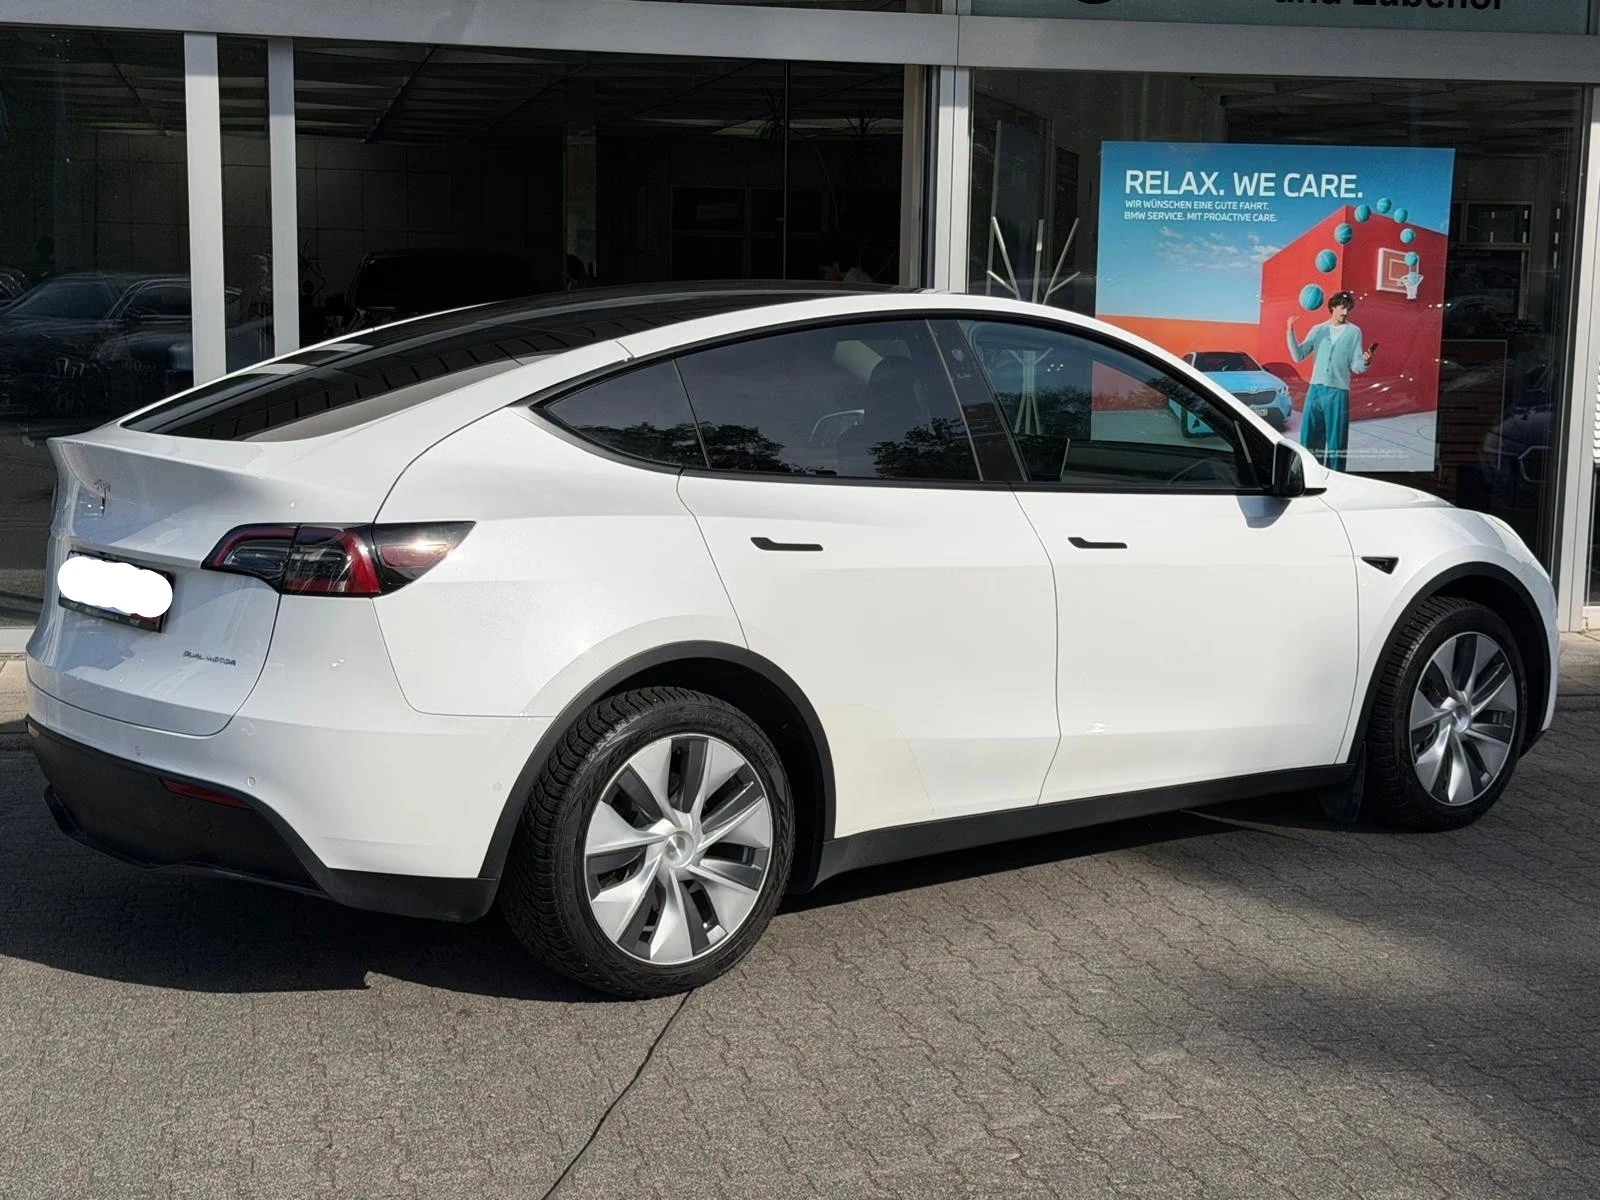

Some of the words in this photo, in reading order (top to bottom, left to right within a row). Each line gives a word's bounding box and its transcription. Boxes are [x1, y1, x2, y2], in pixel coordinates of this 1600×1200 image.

[1125, 169, 1225, 196] RELAX.
[1233, 172, 1276, 197] WE
[1283, 172, 1363, 198] CARE.
[1125, 199, 1142, 209] WIR
[1143, 199, 1192, 210] WÜNSCHEN
[1193, 201, 1213, 210] EINE
[1214, 201, 1238, 210] GUTE
[1239, 202, 1269, 211] FAHRT.
[1124, 211, 1146, 220] BMW
[1147, 212, 1185, 221] SERVICE.
[1187, 213, 1202, 221] MIT
[1203, 213, 1252, 222] PROACTIVE
[1252, 213, 1278, 222] CARE.
